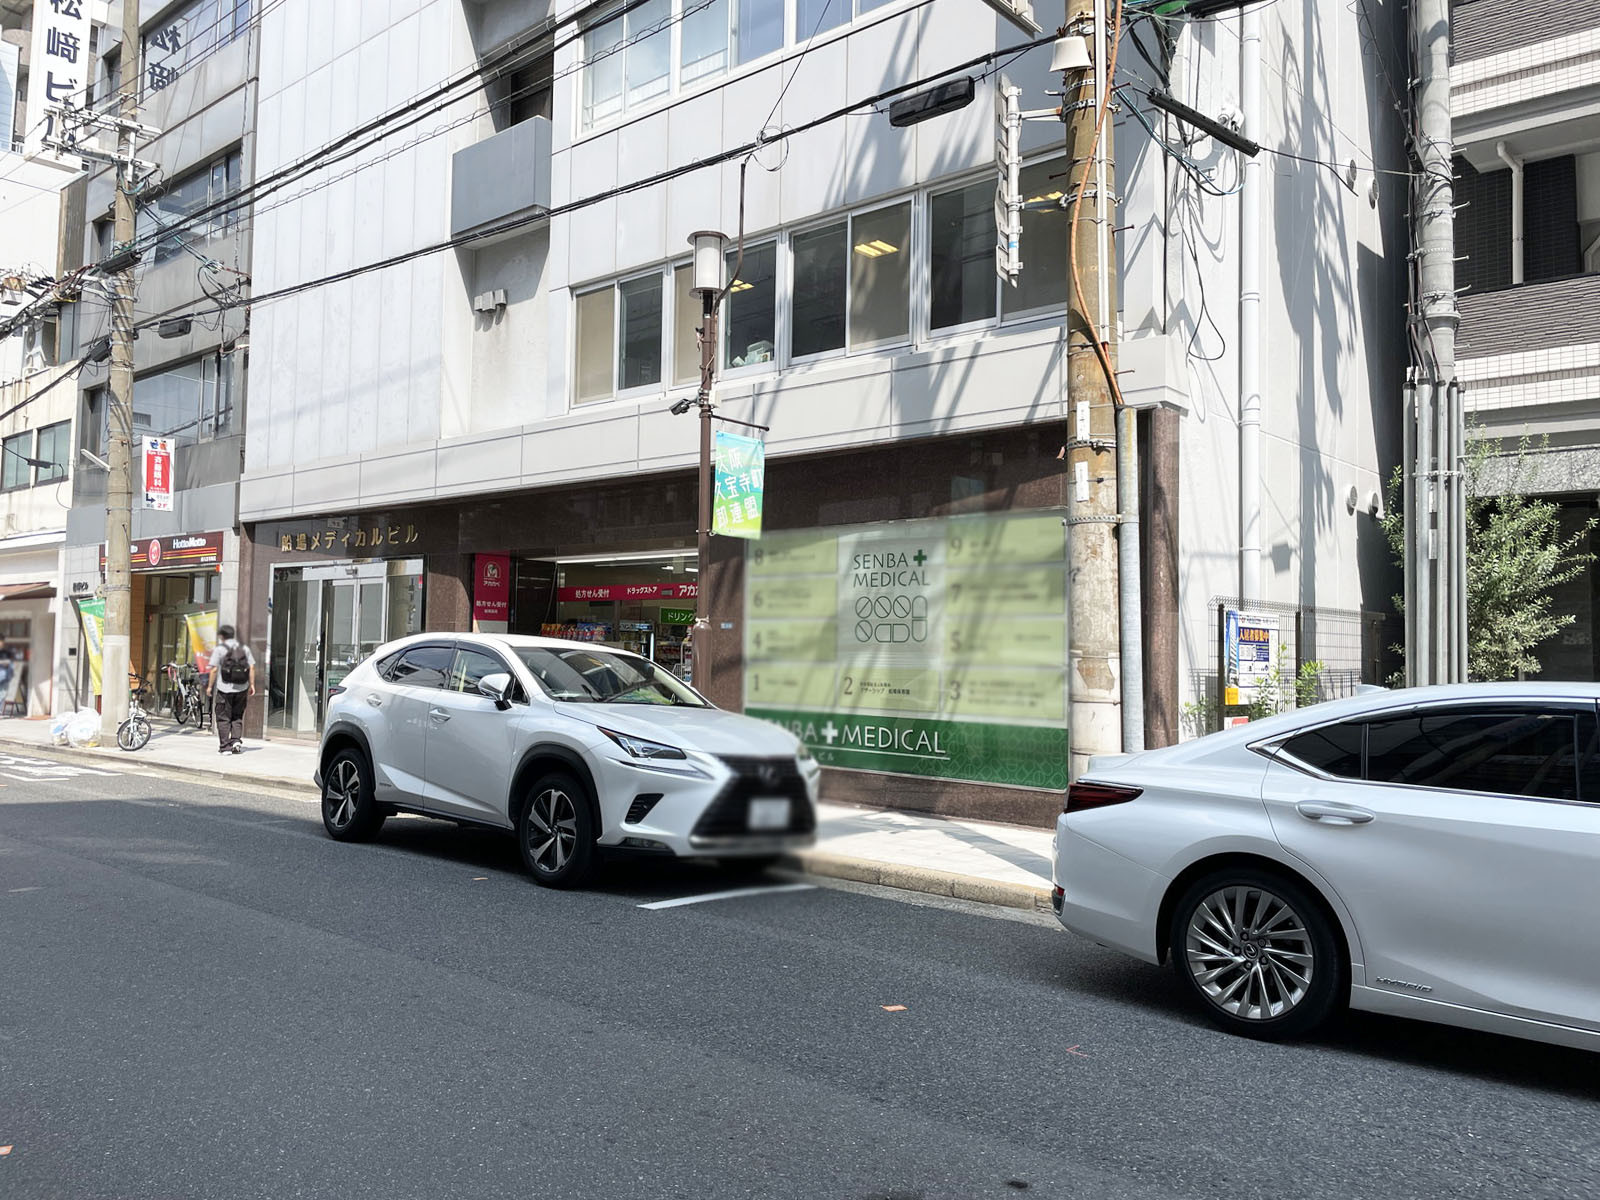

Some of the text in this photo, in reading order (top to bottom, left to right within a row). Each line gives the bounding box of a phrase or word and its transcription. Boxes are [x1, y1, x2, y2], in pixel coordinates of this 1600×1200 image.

[716, 448, 743, 474] 大阪
[281, 524, 419, 552] 船場メディカルビル
[853, 551, 909, 570] SENBA
[853, 570, 931, 588] MEDICAL
[575, 585, 698, 599] 処方せん受付 ドラッグストア アカ
[844, 676, 853, 695] 2
[842, 725, 946, 753] MEDICAL
